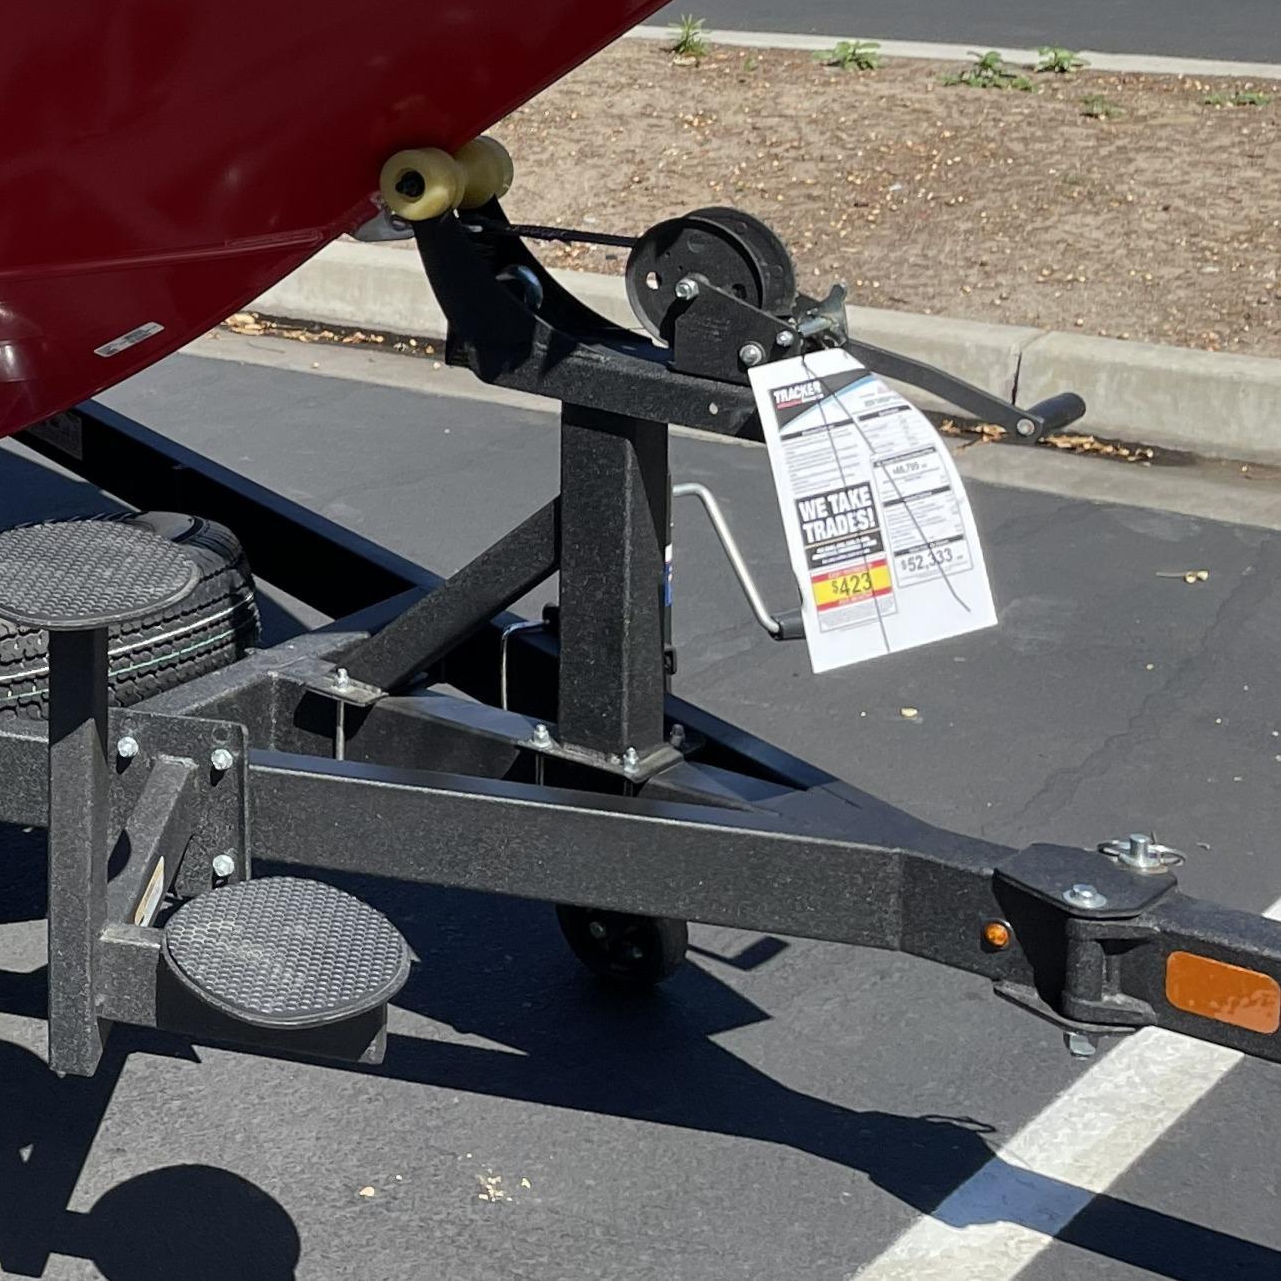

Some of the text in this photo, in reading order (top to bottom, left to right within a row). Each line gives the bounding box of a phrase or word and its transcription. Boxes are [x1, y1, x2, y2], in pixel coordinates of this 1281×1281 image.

[773, 380, 823, 403] TRACKER
[798, 497, 829, 522] WE
[827, 486, 872, 514] TAKE
[802, 507, 876, 543] TRADES!
[901, 548, 953, 572] $52,333
[832, 572, 872, 596] $423
